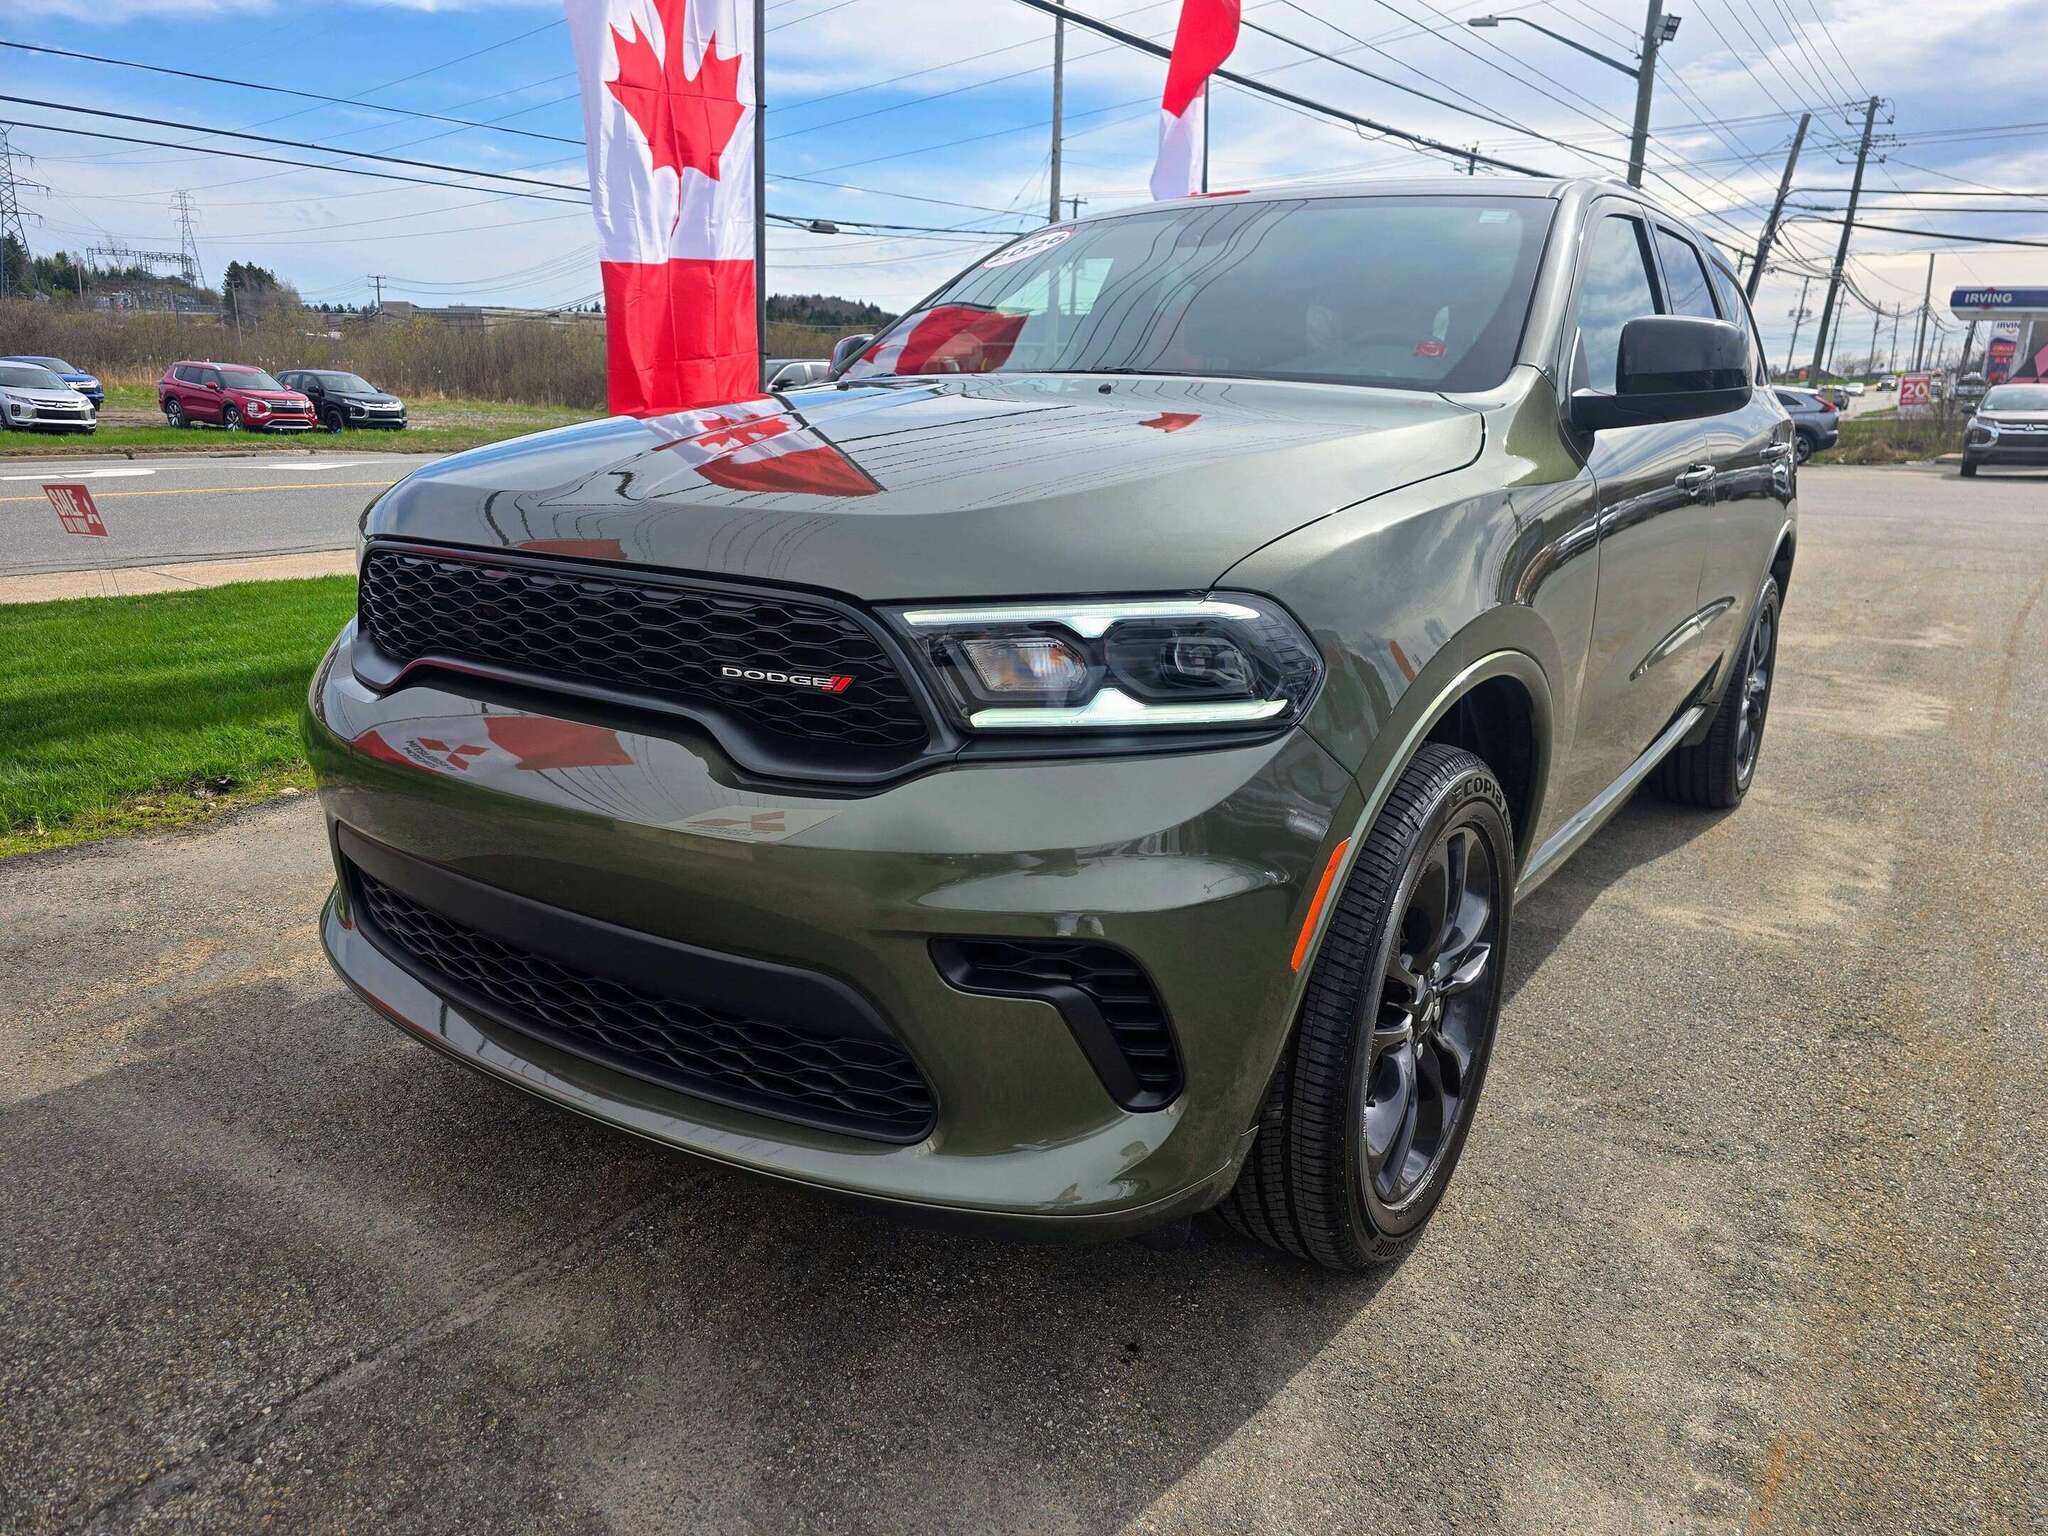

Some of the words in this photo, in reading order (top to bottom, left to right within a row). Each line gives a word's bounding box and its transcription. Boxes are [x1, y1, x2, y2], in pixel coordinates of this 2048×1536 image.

[1964, 292, 2013, 304] IRVING
[1996, 321, 2020, 329] IRVIN
[47, 488, 84, 516] SALE
[721, 666, 834, 689] DODGE
